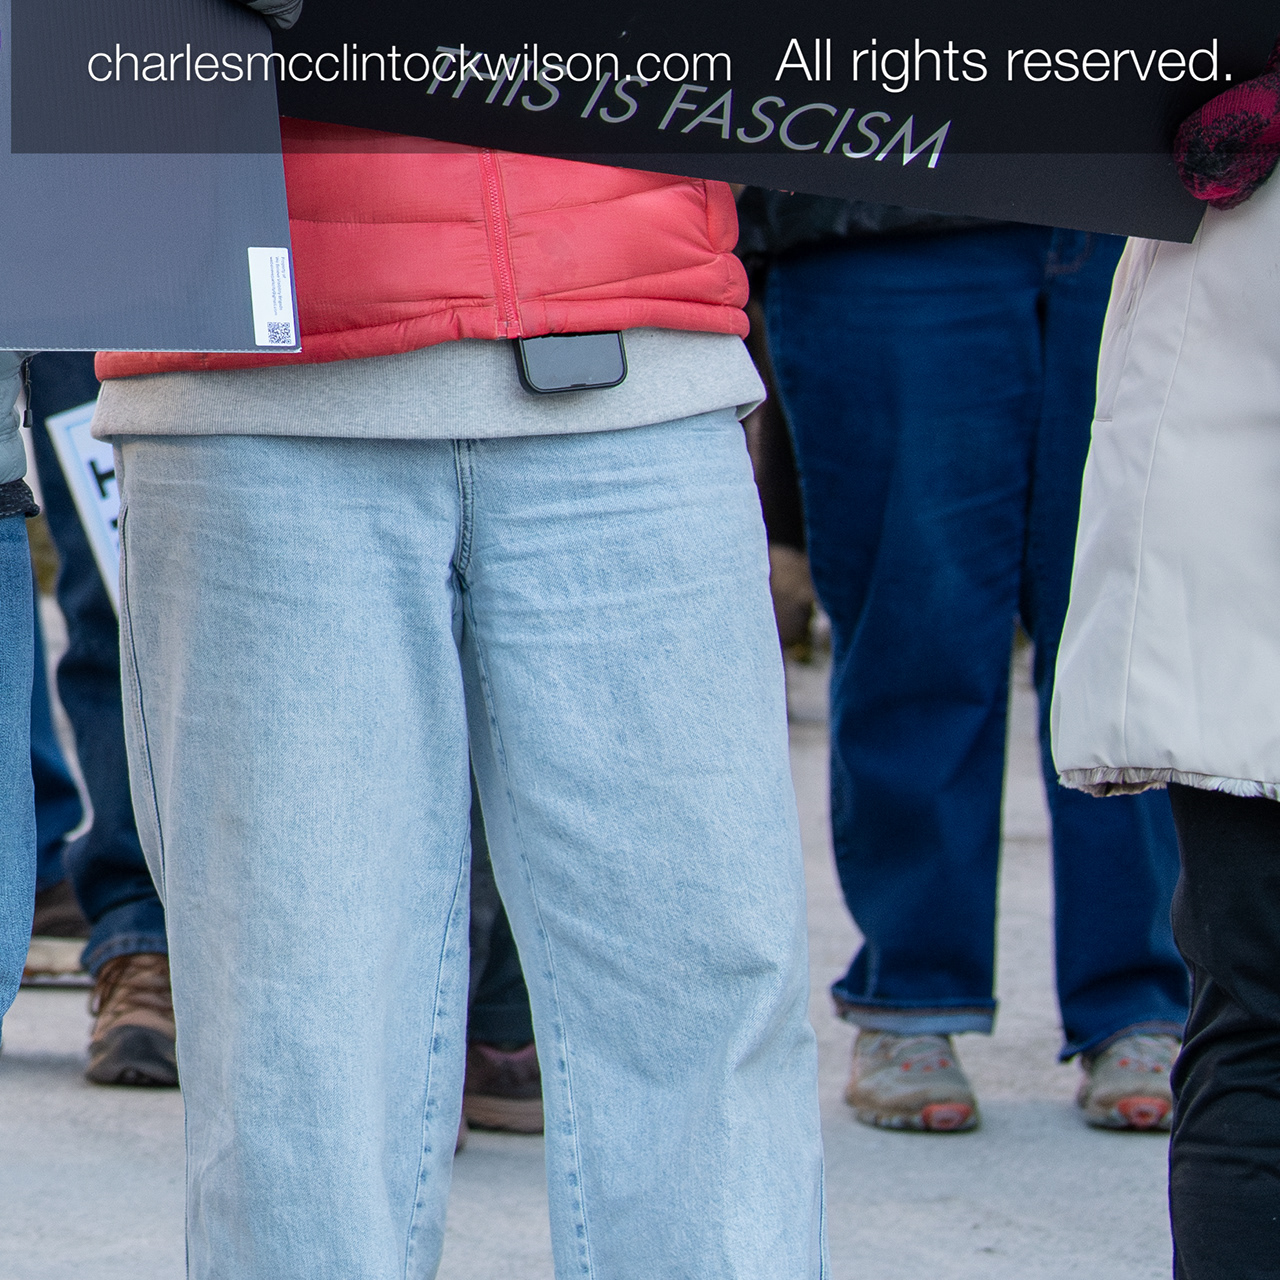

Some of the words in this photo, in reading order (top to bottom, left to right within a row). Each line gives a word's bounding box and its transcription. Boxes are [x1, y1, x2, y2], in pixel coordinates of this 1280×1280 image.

[426, 46, 567, 114] THIS
[580, 71, 648, 123] IS
[657, 83, 952, 169] FASCISM
